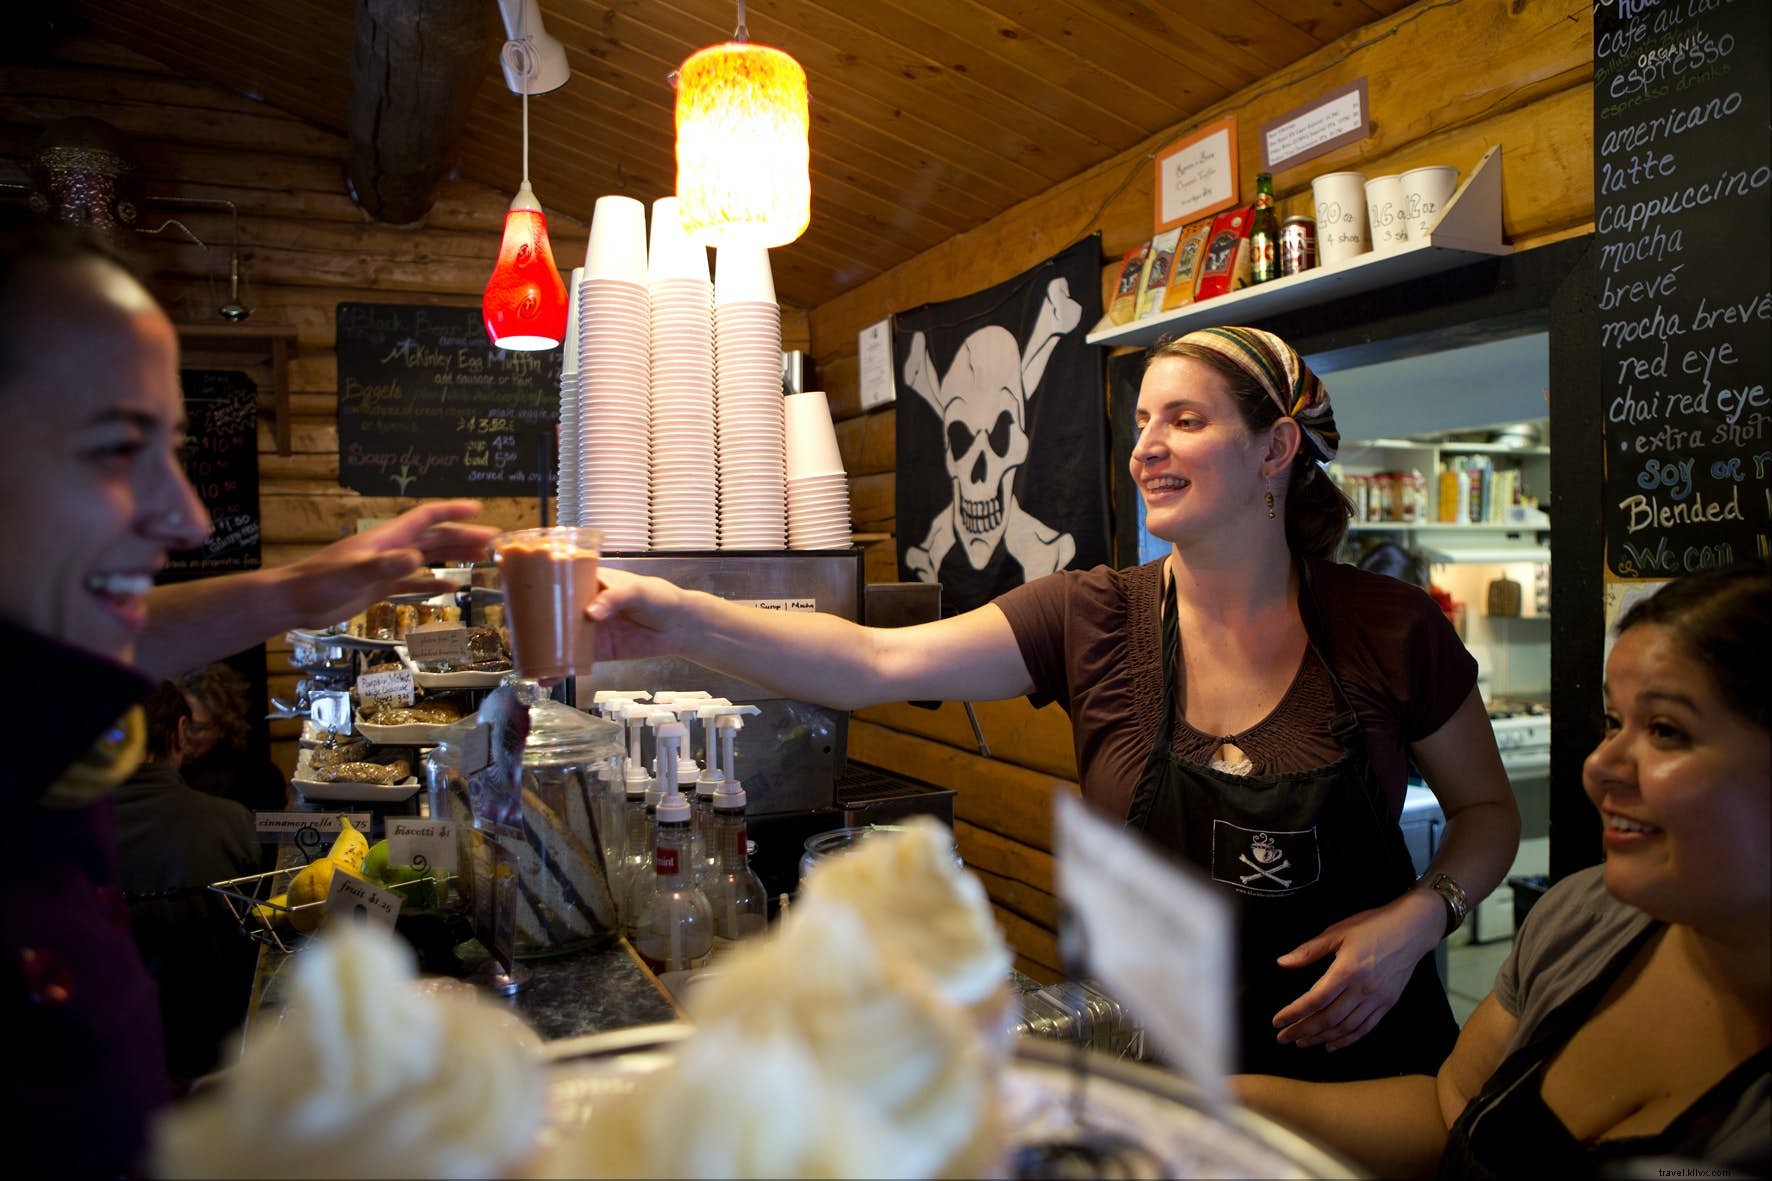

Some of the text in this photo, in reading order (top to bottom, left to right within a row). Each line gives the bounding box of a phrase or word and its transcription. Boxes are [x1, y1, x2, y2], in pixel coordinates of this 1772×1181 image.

[1597, 15, 1650, 57] café
[1654, 5, 1684, 33] au
[1637, 31, 1709, 68] ORGANIC
[1610, 33, 1735, 98] espresso
[1601, 92, 1743, 156] americano
[1601, 151, 1677, 195] latte
[1318, 201, 1341, 229] 20
[1372, 202, 1394, 228] 16
[1406, 193, 1436, 219] 12 oz
[1598, 166, 1771, 234] cappuccino
[1600, 224, 1684, 272] mocha
[1598, 264, 1685, 310] brevé
[1602, 305, 1686, 349] mocha
[1618, 341, 1738, 384] red eye
[1609, 380, 1770, 425] chai red eye
[1637, 458, 1695, 500] Soy
[1619, 485, 1744, 534] Blended
[1623, 537, 1679, 571] We
[258, 818, 307, 829] cinnamon
[309, 816, 332, 829] rolls
[394, 825, 434, 838] biscotti
[339, 880, 365, 899] fruit
